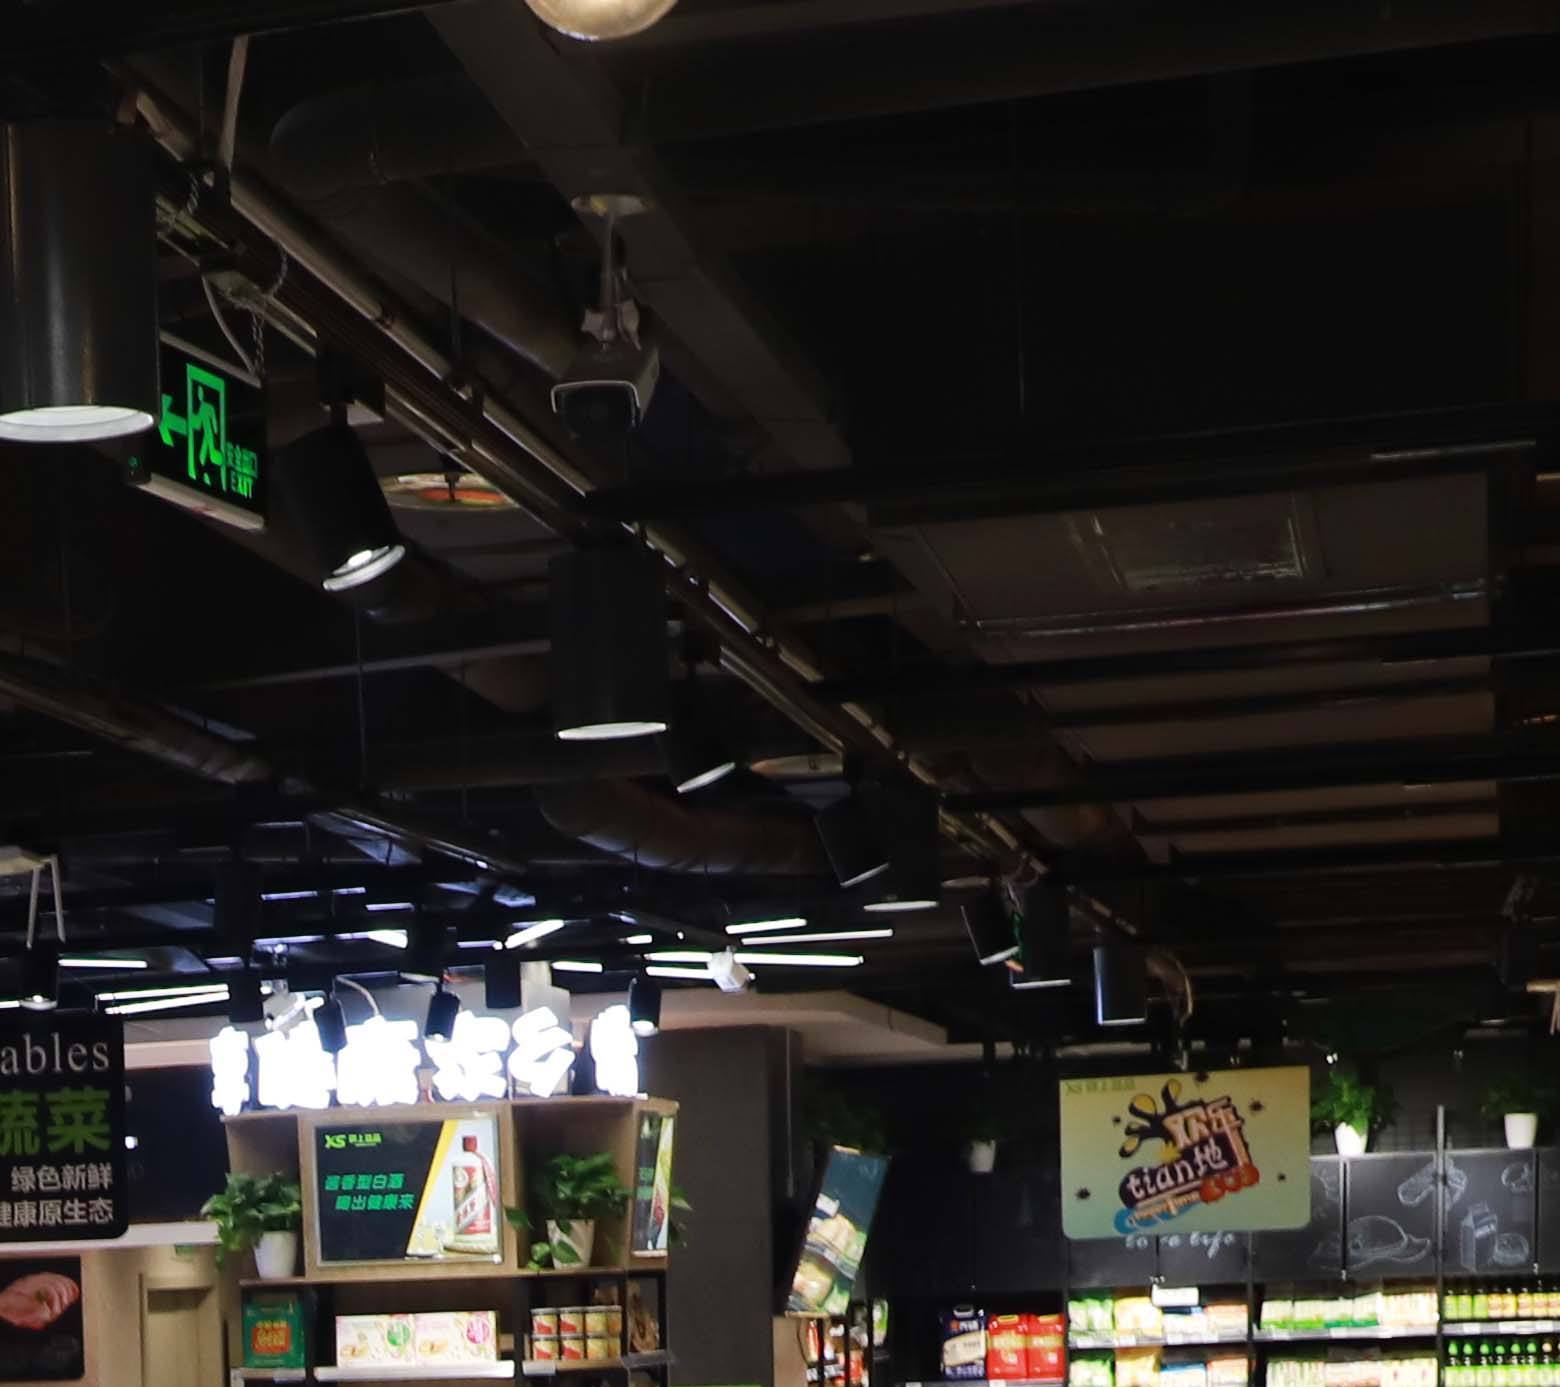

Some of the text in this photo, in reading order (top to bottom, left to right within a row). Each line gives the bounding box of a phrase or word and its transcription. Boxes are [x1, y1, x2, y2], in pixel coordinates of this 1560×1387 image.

[231, 472, 253, 499] EXIT
[10, 1163, 113, 1193] 绿色新鲜
